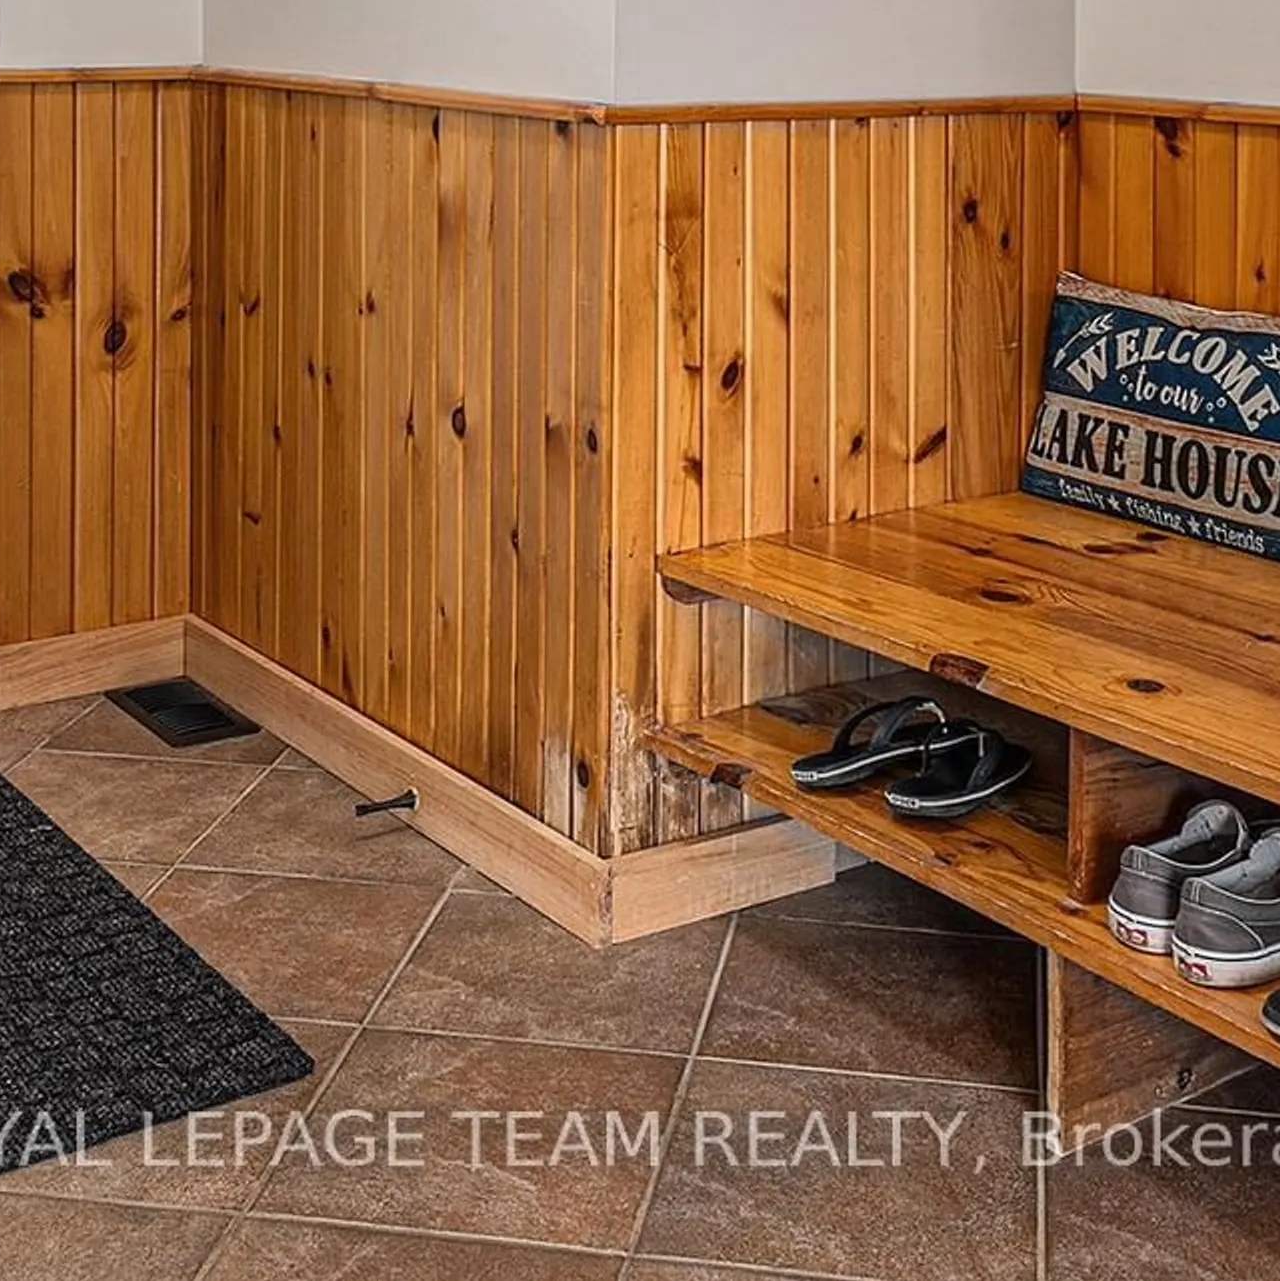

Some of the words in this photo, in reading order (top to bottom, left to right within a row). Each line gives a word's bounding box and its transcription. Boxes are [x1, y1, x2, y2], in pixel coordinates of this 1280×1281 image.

[1067, 327, 1280, 432] WELCOME
[1133, 366, 1156, 401] to
[1160, 386, 1205, 414] our
[1031, 401, 1129, 479] LAKE
[1058, 478, 1105, 510] family
[1126, 497, 1186, 534] fishing
[1205, 519, 1265, 553] friends
